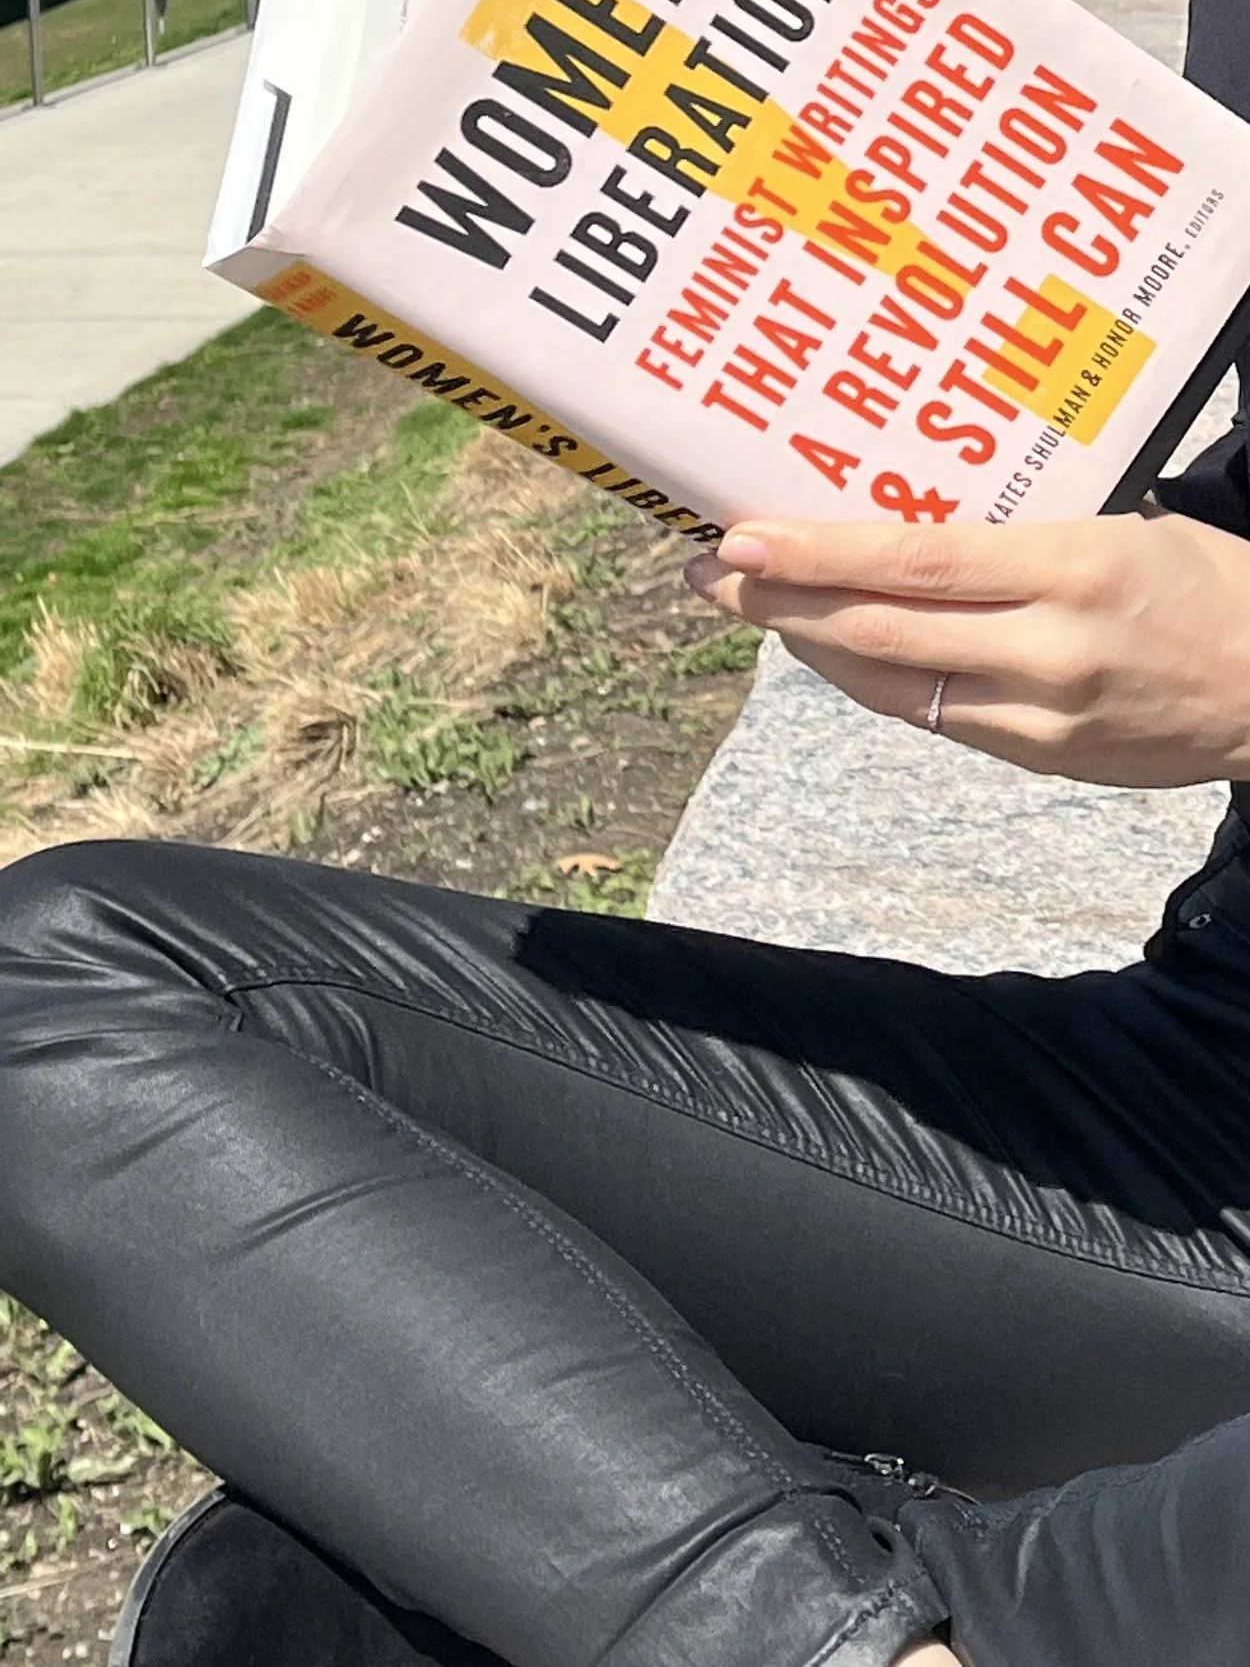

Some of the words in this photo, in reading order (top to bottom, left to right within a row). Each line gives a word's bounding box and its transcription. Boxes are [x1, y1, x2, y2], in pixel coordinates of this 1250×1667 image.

[702, 279, 836, 431] THAT
[803, 13, 1015, 285] INSPIRED
[823, 65, 1097, 429] REVOLUTION
[1184, 187, 1225, 239] EDITORS
[636, 177, 798, 390] FEMINIST
[871, 471, 960, 523] &
[916, 277, 1088, 465] STILL
[1041, 118, 1184, 277] CAN
[1081, 368, 1103, 388] &
[1091, 307, 1142, 371] HONOR
[332, 313, 578, 458] WOMEN'S
[1024, 384, 1092, 471] SHULMAN
[789, 434, 861, 490] A
[985, 472, 1033, 525] KATES
